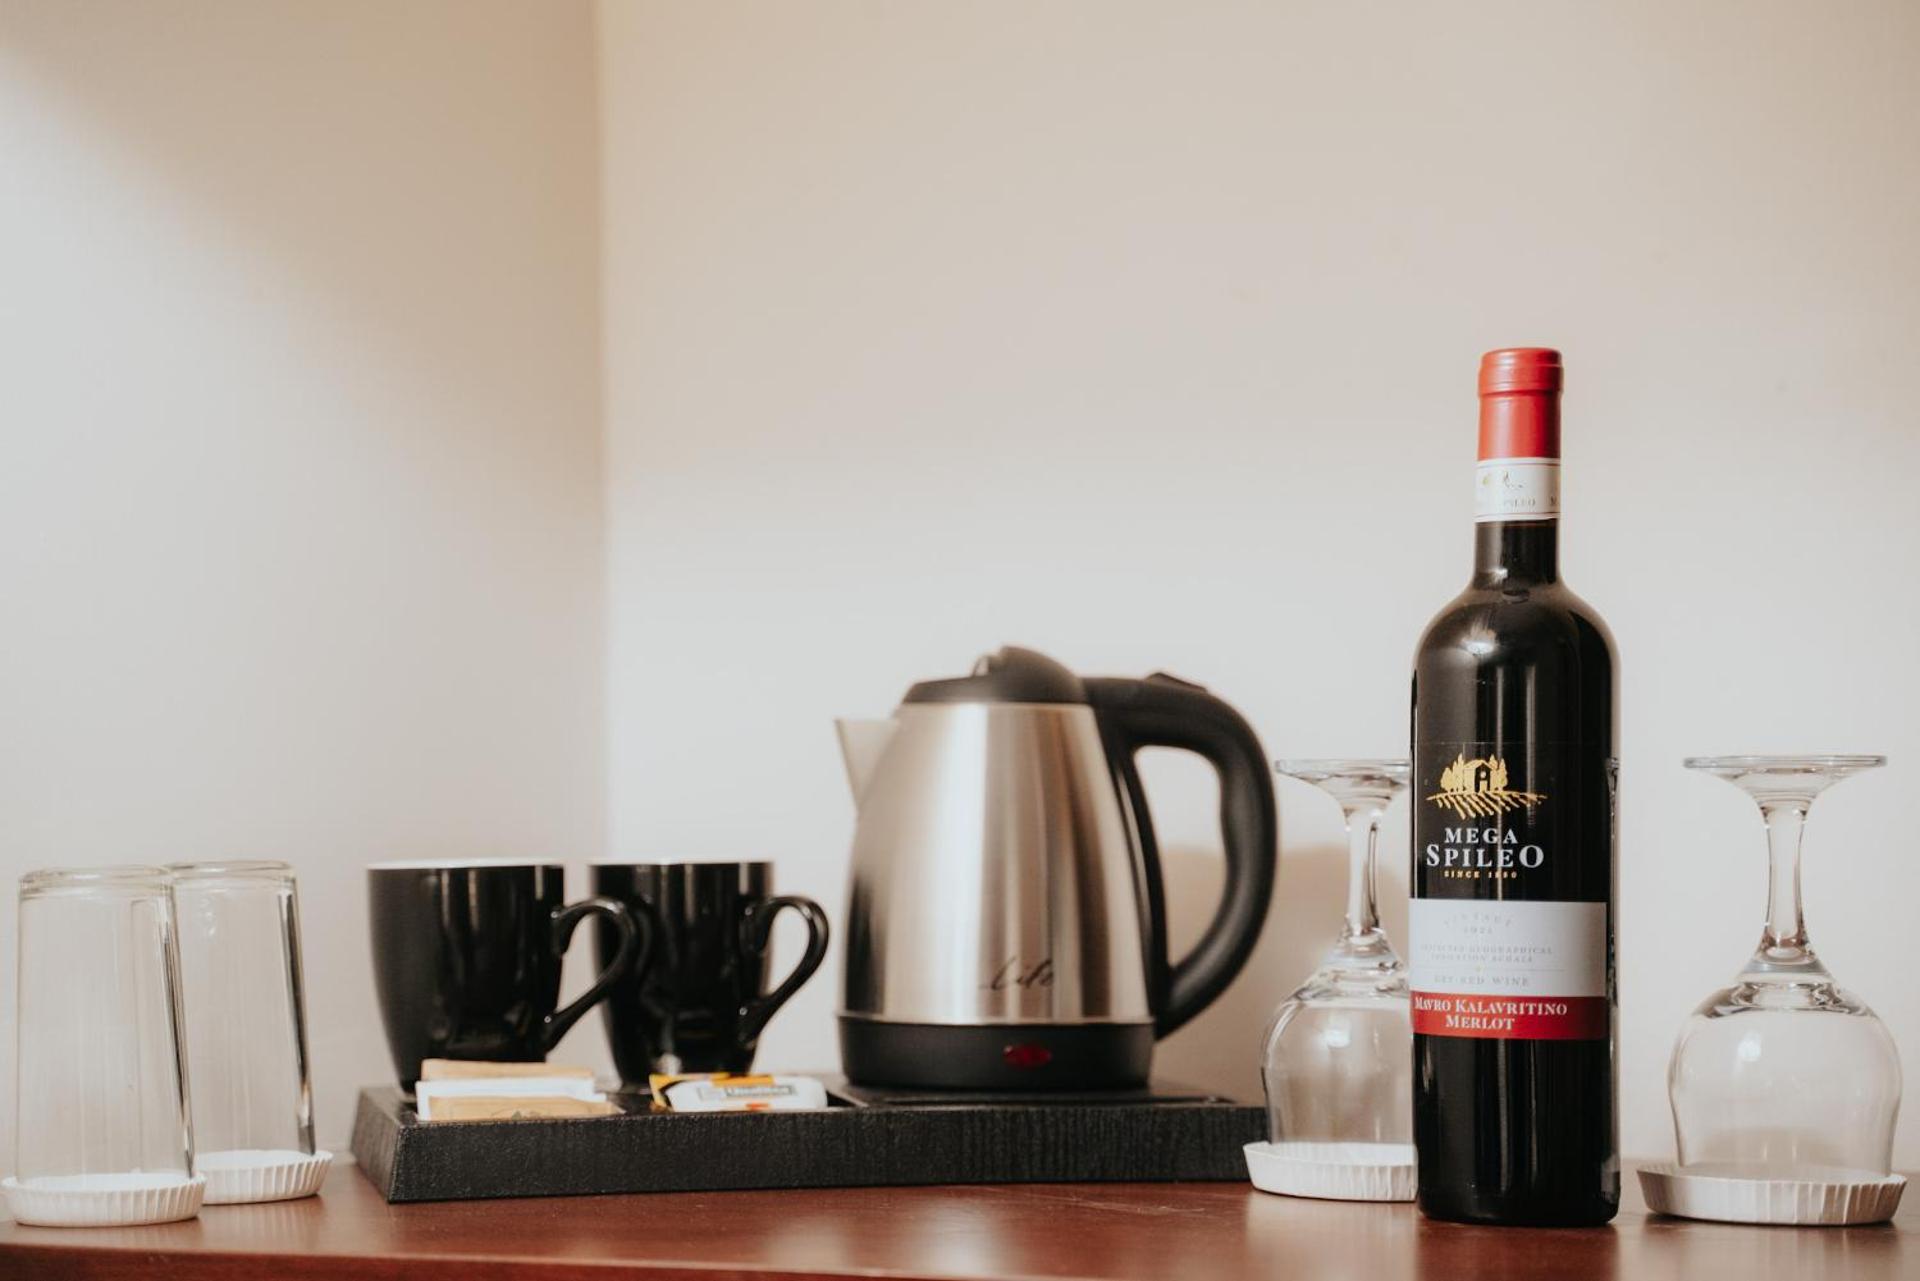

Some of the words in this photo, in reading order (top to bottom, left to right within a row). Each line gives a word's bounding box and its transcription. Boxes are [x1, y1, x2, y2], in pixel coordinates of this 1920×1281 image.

[1444, 827, 1518, 844] MEGA
[1426, 844, 1545, 868] SPILEO
[1444, 870, 1480, 879] SINCE
[1492, 976, 1529, 986] WINE
[1455, 999, 1568, 1015] KALAVRITINO
[1445, 1015, 1515, 1030] MERLOT
